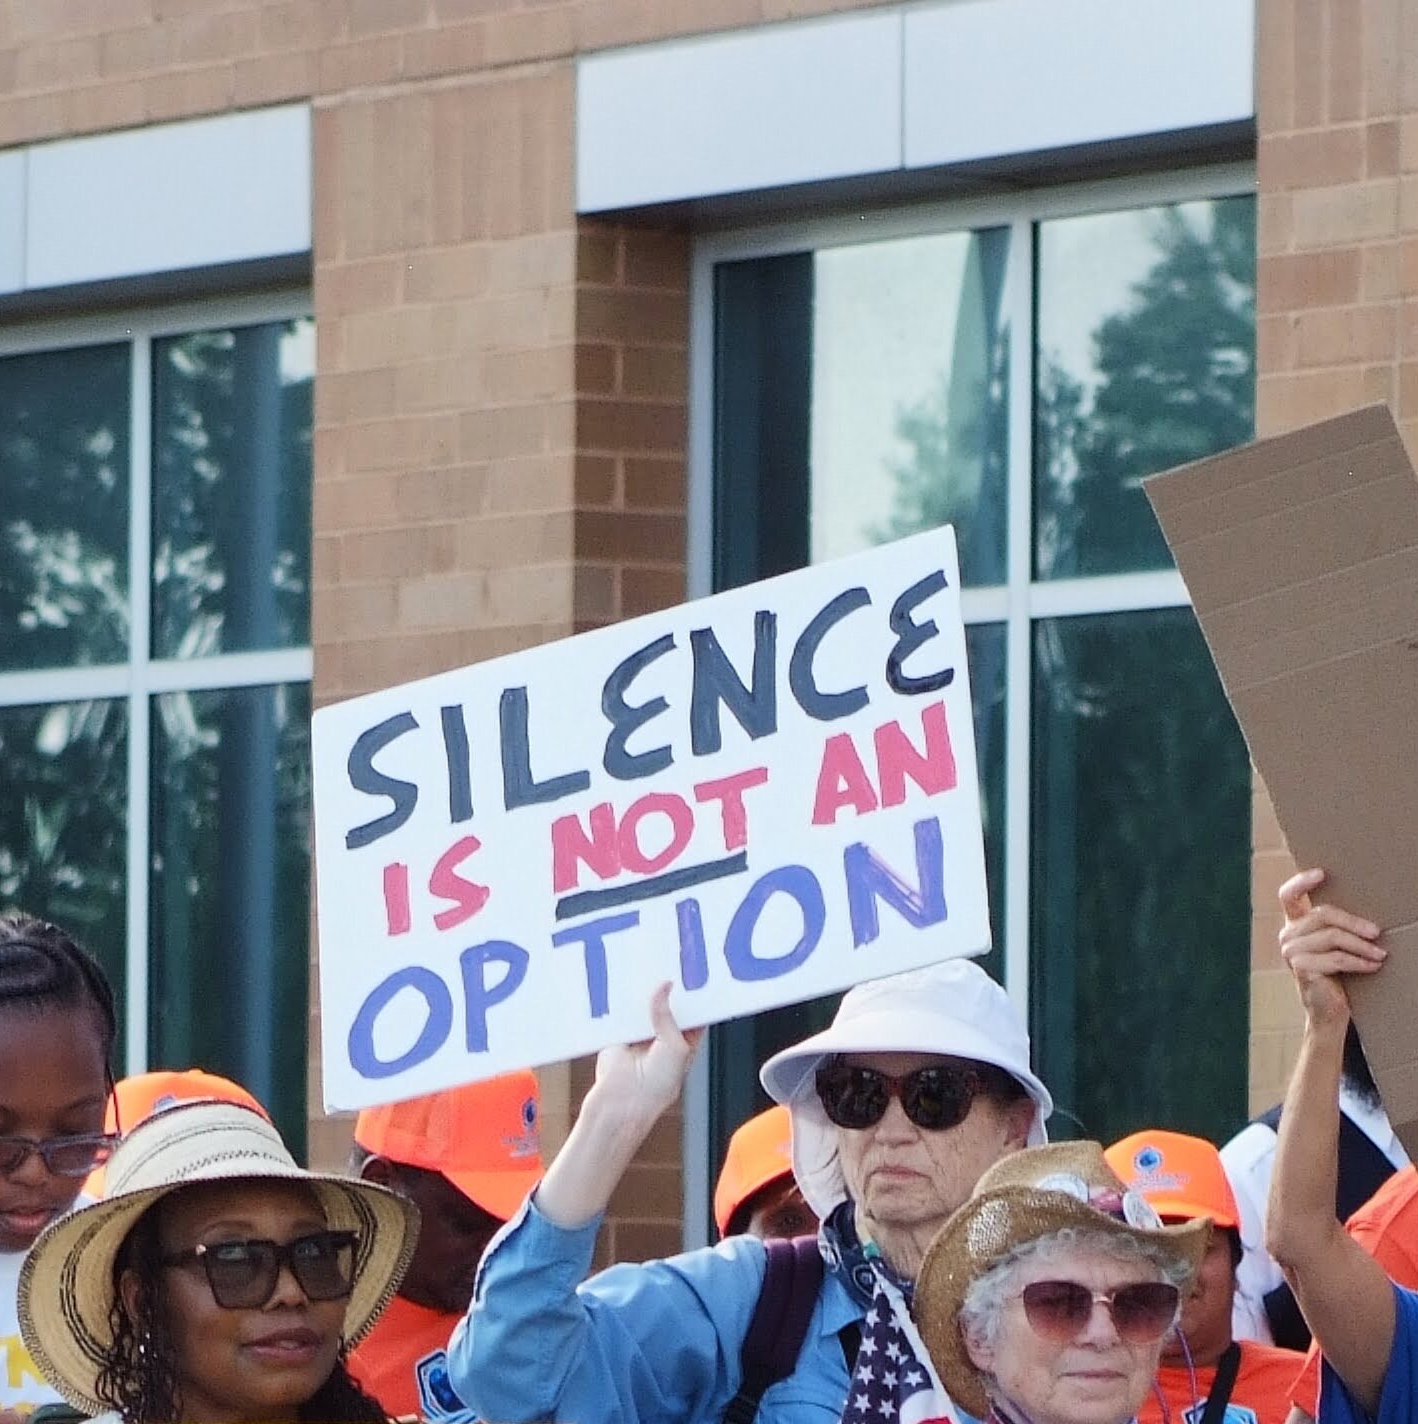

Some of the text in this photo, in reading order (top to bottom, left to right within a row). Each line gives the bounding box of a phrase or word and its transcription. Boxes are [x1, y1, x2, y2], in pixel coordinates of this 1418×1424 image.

[345, 569, 954, 849] SILENCE
[383, 700, 957, 936] IS NOT AN
[347, 817, 948, 1079] OPTION
